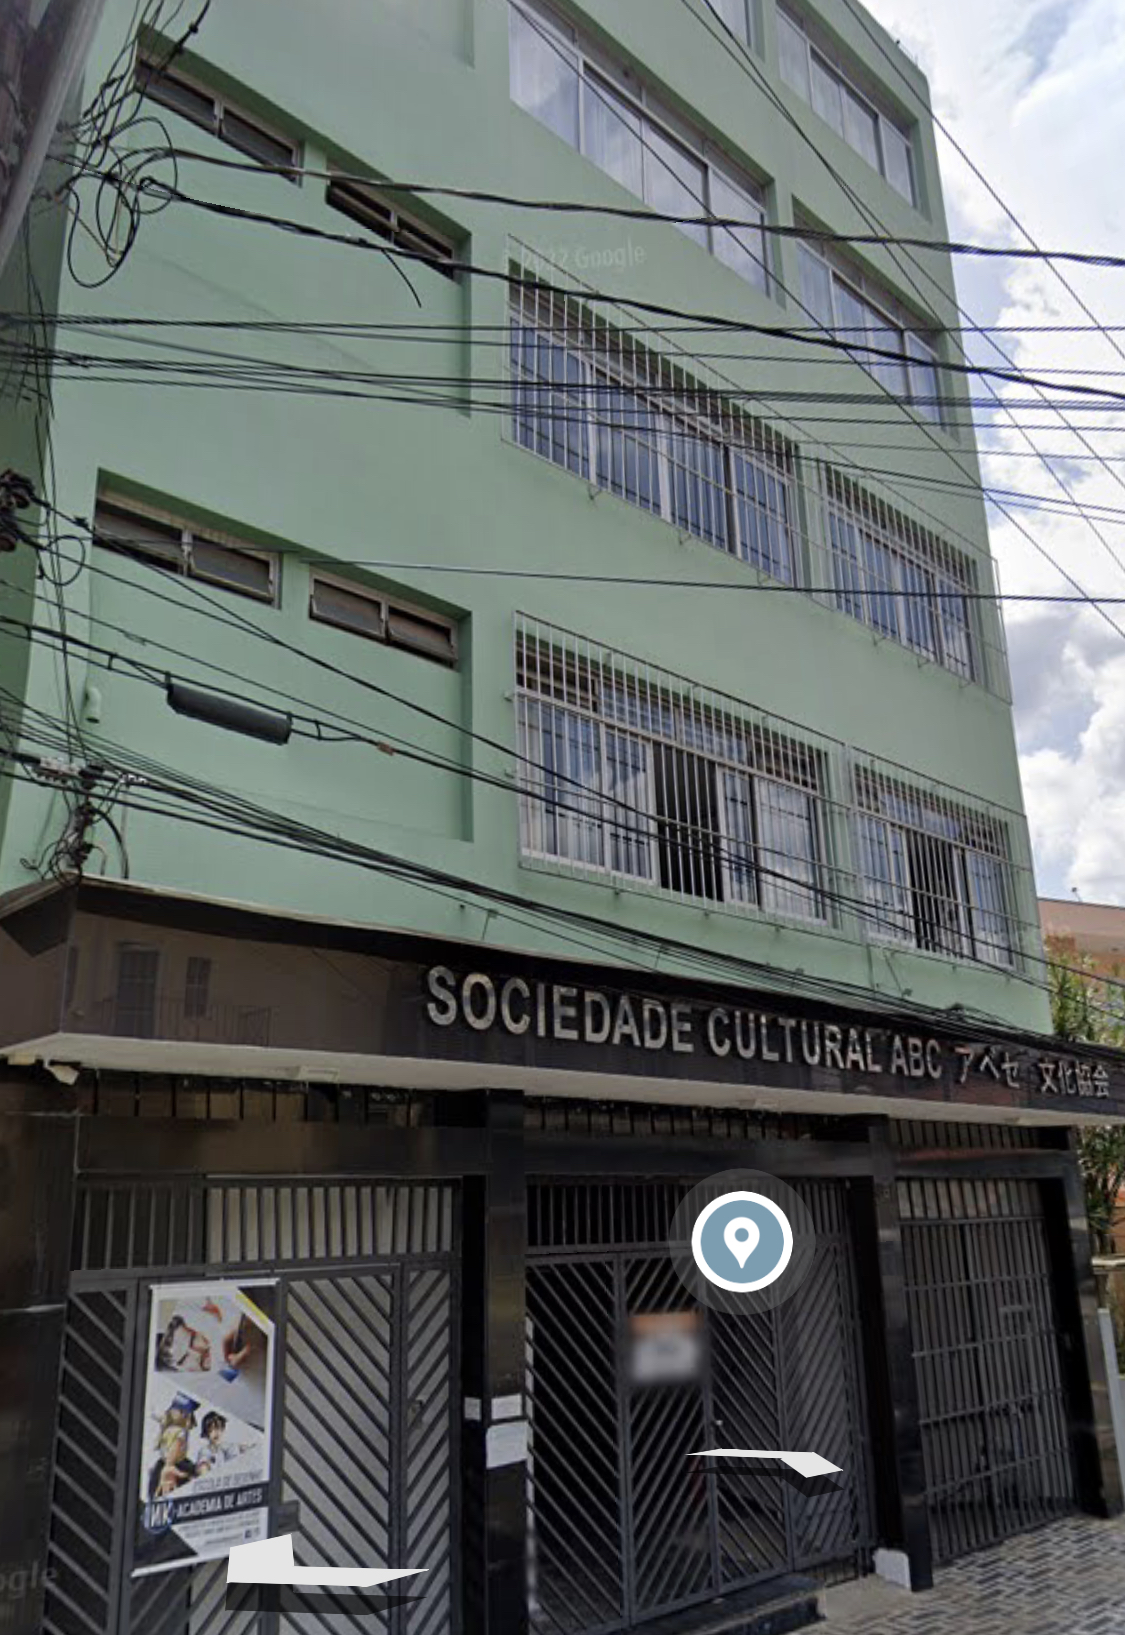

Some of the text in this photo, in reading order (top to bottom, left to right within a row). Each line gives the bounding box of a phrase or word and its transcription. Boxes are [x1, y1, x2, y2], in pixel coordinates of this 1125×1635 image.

[427, 965, 943, 1079] SOCIEDADE CULTURAL ABC
